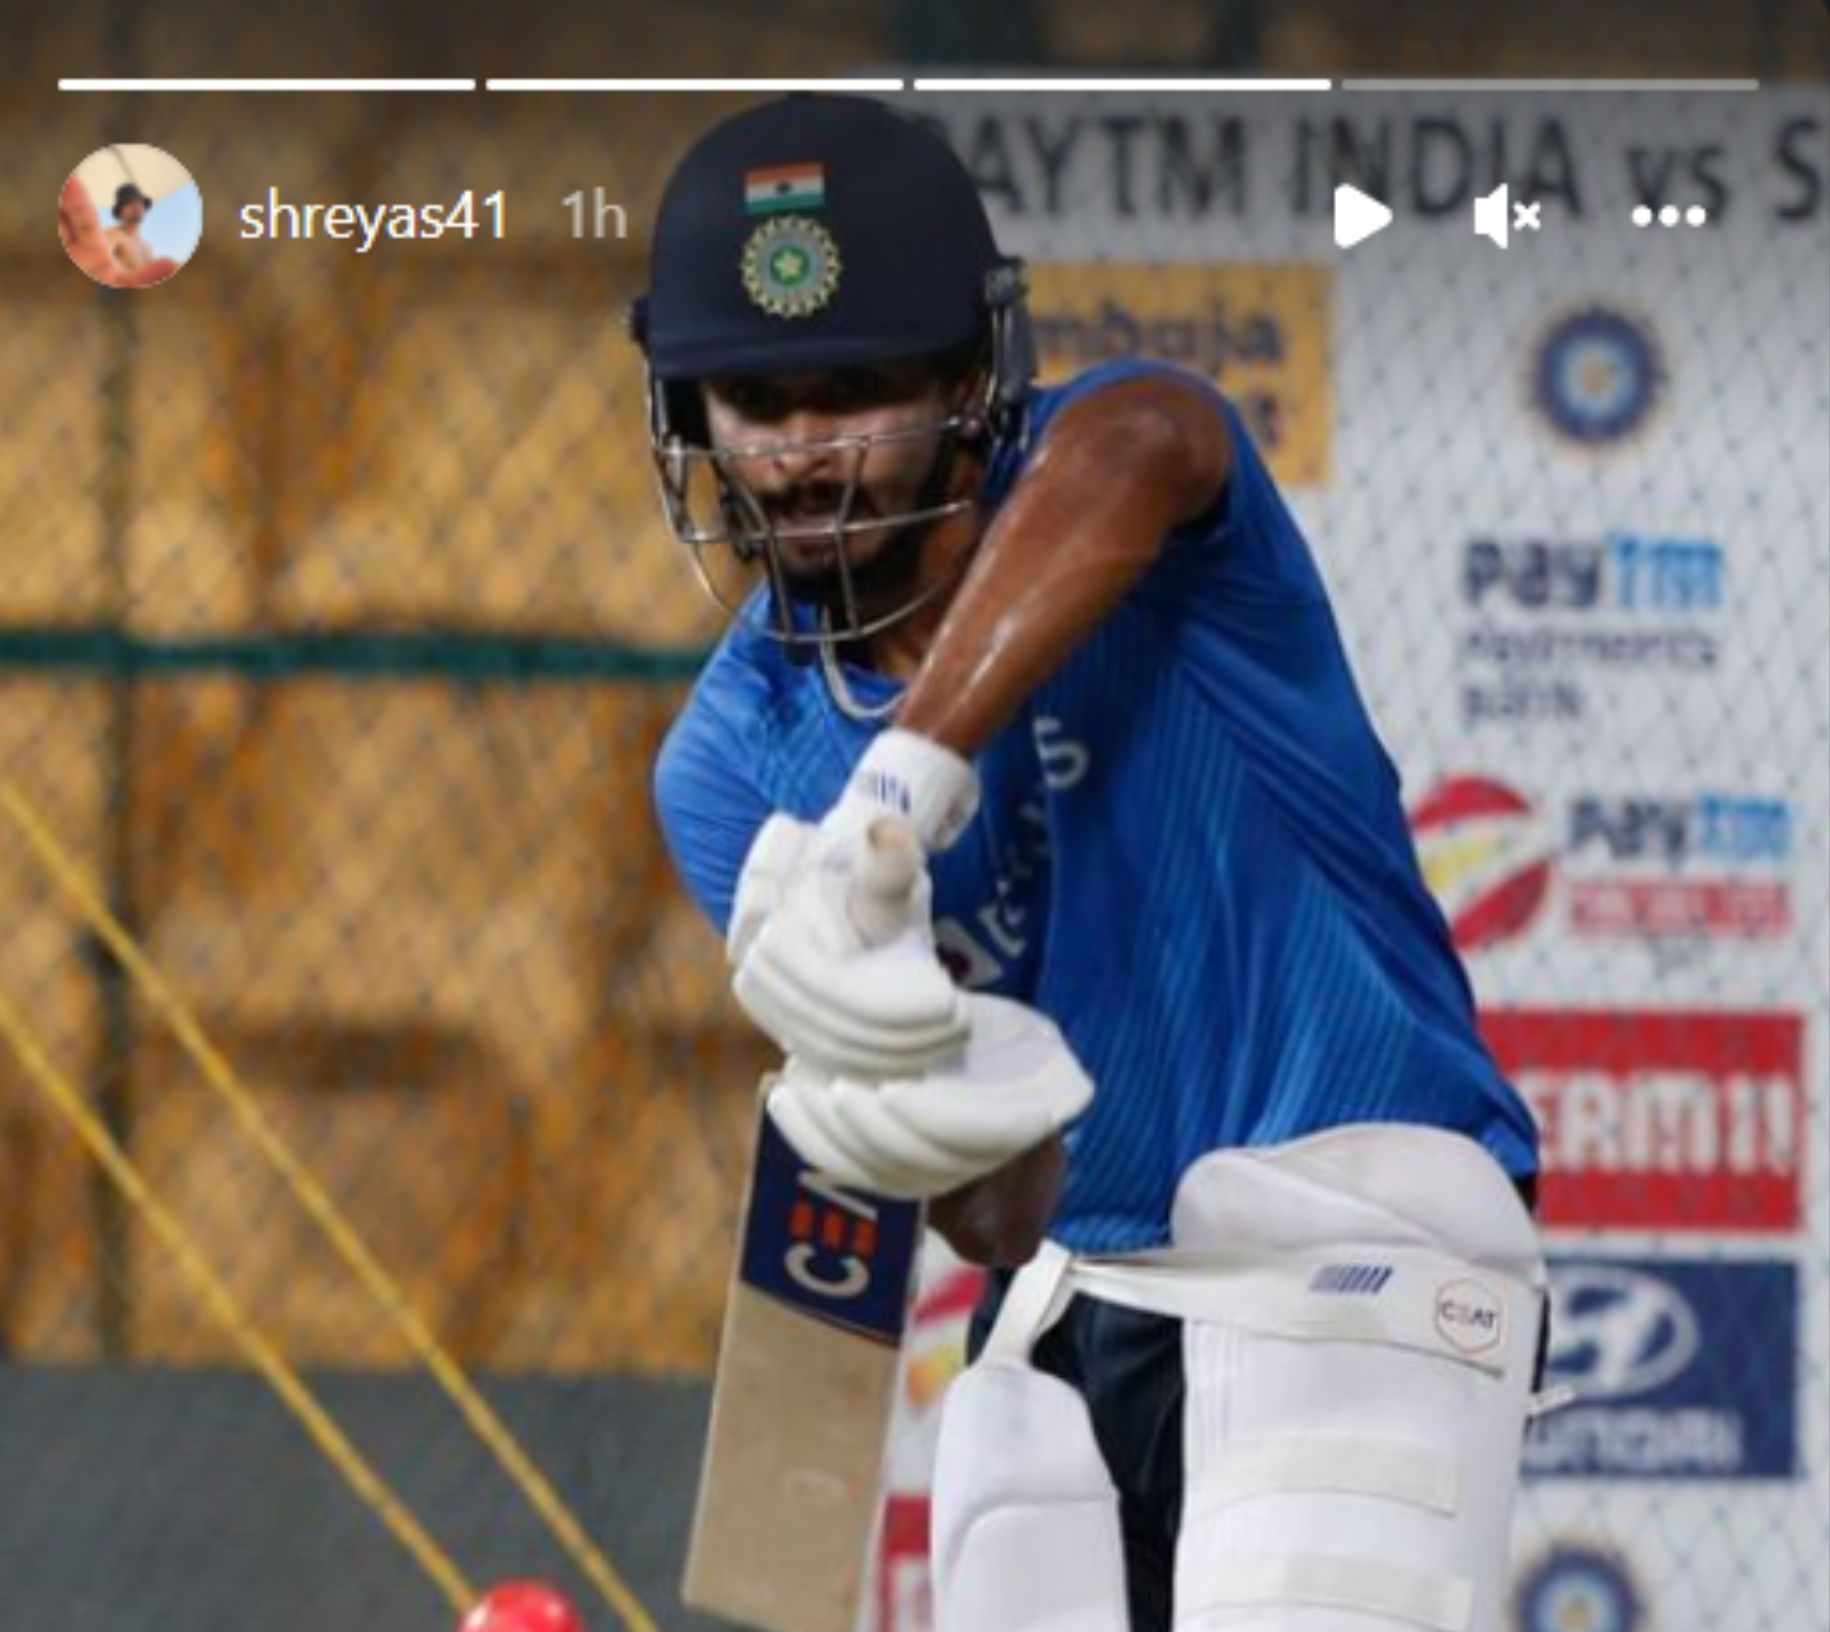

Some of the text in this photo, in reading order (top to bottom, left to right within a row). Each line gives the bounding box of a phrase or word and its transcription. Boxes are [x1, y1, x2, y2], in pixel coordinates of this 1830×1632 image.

[972, 112, 1248, 220] AYTM
[1294, 112, 1584, 226] INDIA
[1774, 114, 1822, 222] S
[1032, 300, 1286, 376] mbuja
